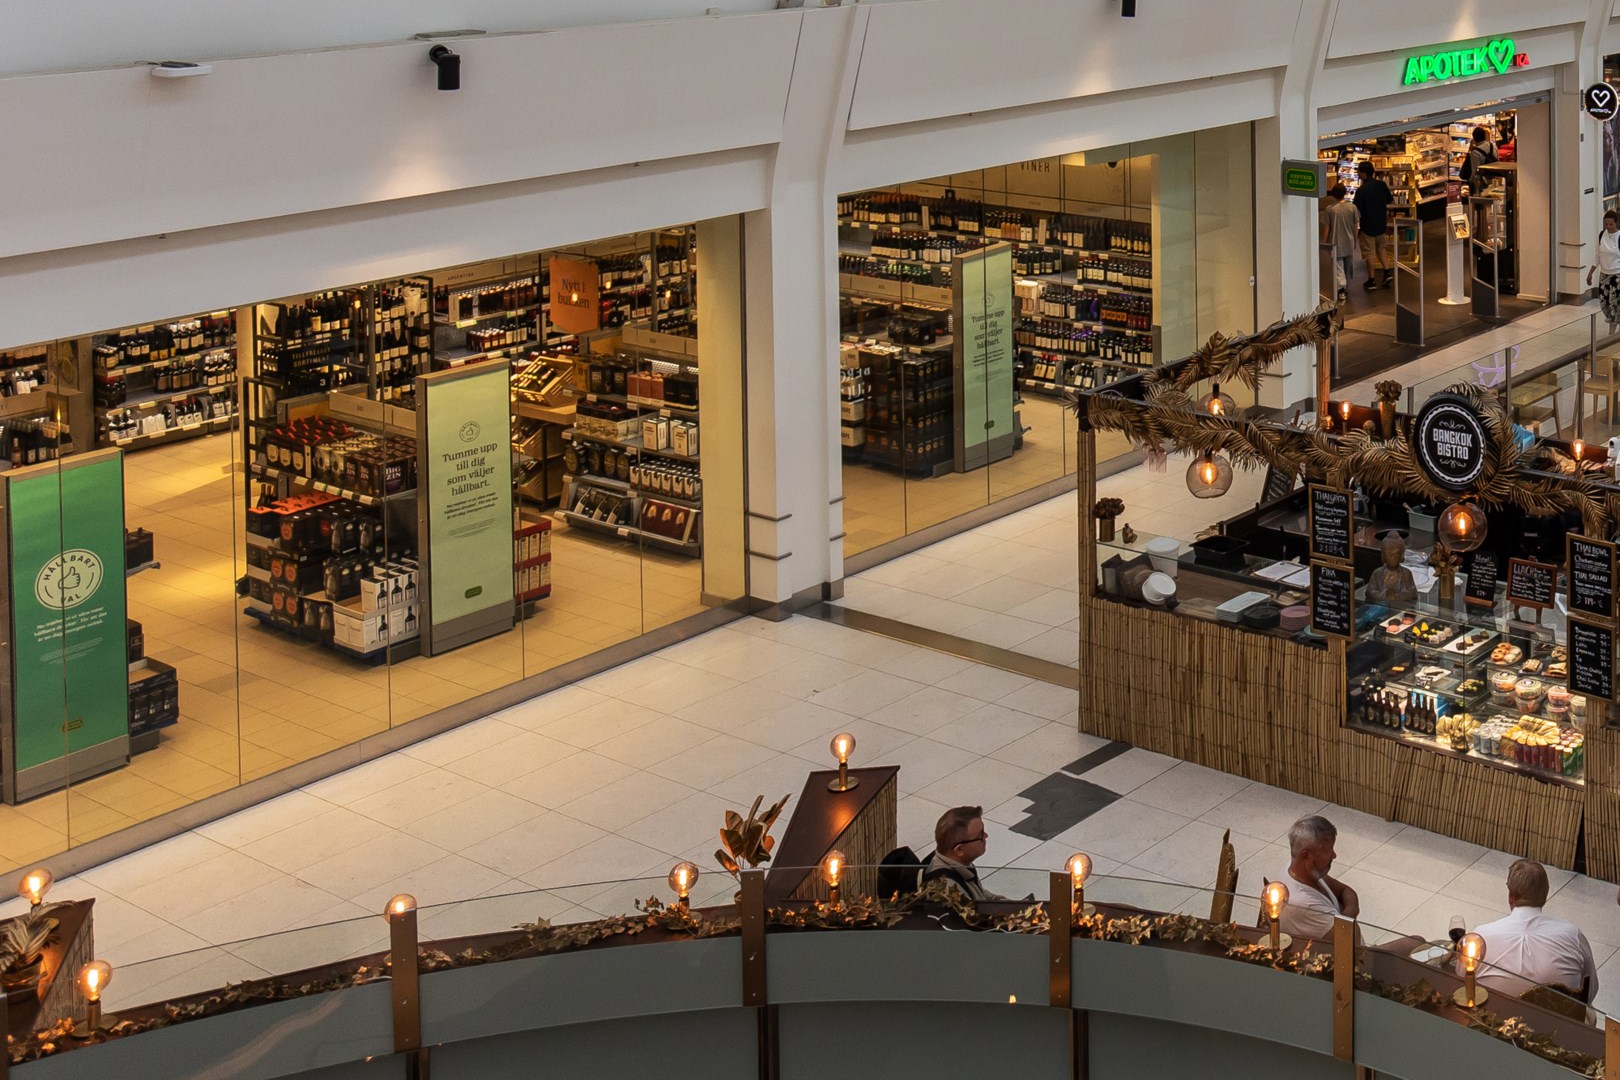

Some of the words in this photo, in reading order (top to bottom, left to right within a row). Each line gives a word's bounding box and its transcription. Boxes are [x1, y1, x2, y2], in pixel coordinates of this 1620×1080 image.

[1403, 46, 1489, 85] APOTEK
[1516, 53, 1530, 66] ICA
[1020, 161, 1050, 173] VINER
[562, 278, 581, 294] Nytt
[1432, 428, 1472, 447] BANGKOK
[442, 447, 479, 463] Tumme
[480, 442, 498, 455] upp
[1437, 442, 1469, 460] BISTRO
[456, 459, 469, 472] till
[471, 457, 486, 468] dig
[447, 474, 467, 486] som
[468, 466, 495, 480] väljer
[451, 479, 490, 497] hållbart.
[43, 555, 96, 581] HÅLLBART
[1321, 567, 1336, 577] FIKA
